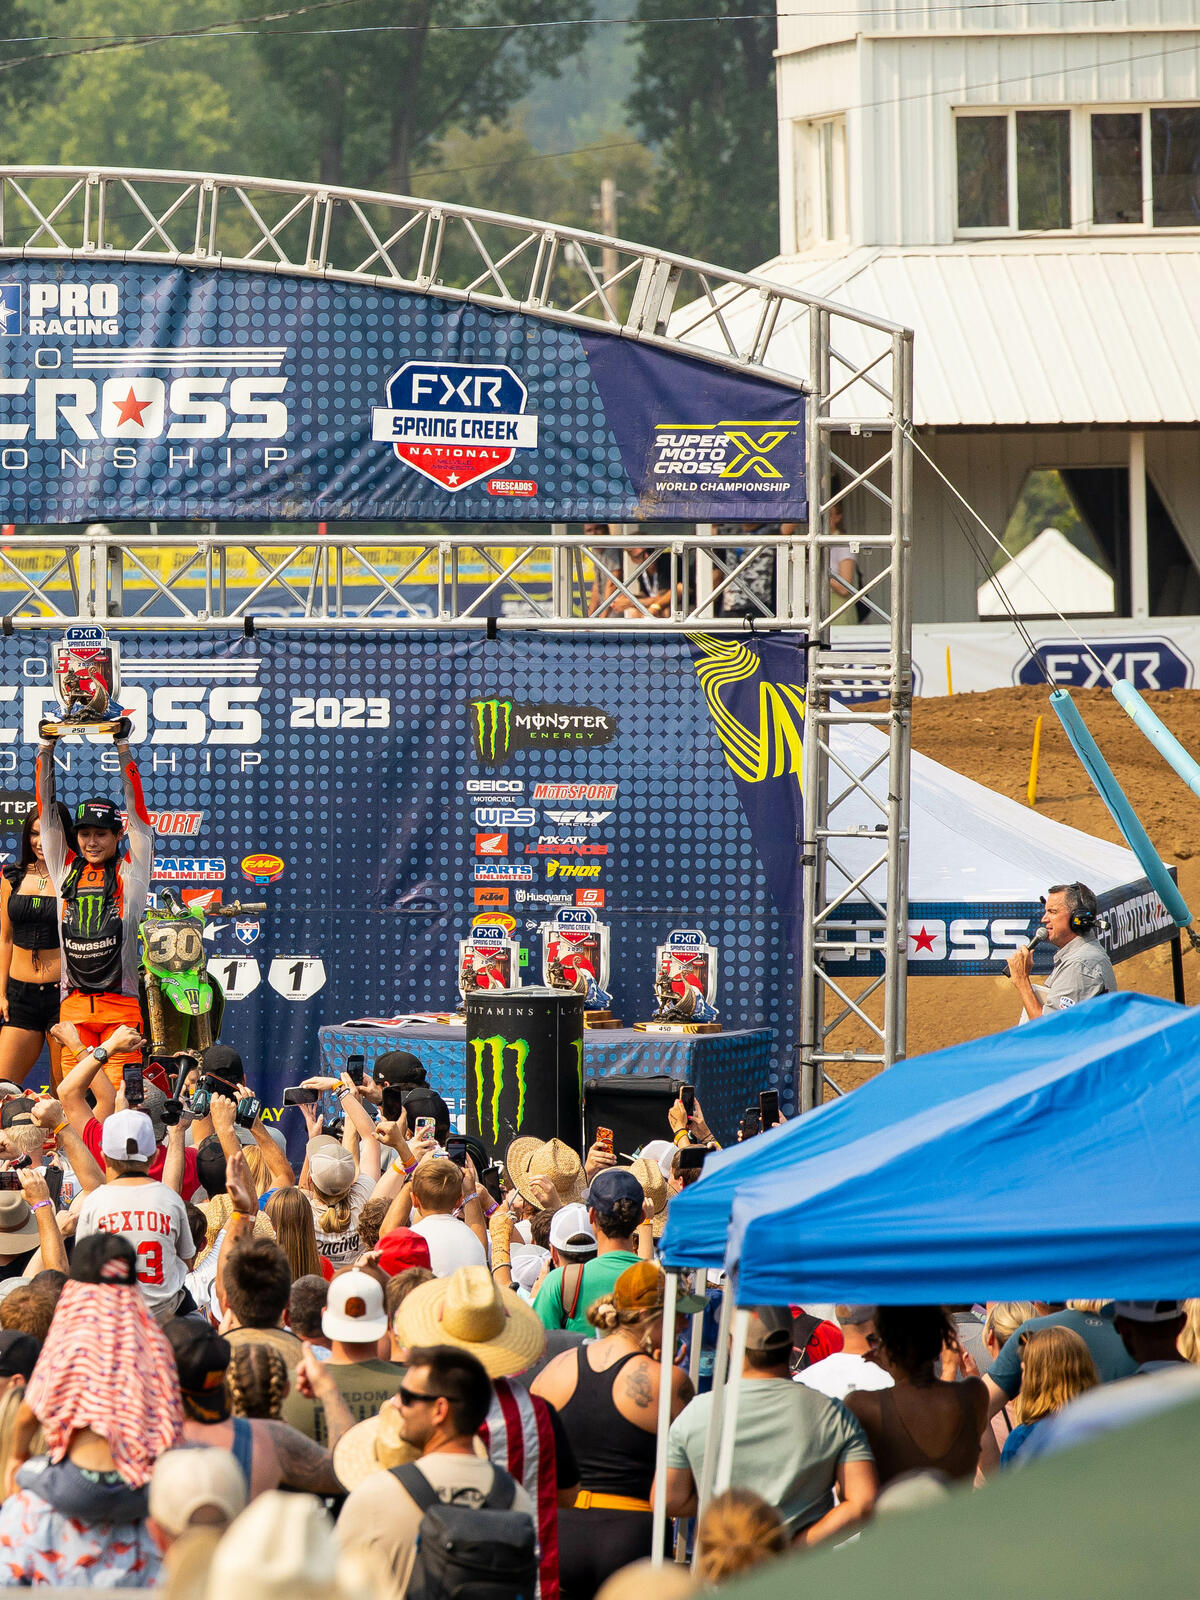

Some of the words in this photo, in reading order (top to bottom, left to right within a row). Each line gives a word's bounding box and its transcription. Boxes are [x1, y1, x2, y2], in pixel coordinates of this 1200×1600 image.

[30, 284, 119, 316] PRO
[29, 319, 119, 336] RACING
[411, 372, 502, 408] FXR
[392, 416, 456, 438] SPRING
[461, 418, 519, 441] CREEK
[655, 434, 731, 447] SUPER
[409, 447, 500, 459] NATIONAL
[659, 448, 725, 461] MOTO
[653, 461, 727, 474] CROSS
[491, 481, 533, 491] FRESCADOS
[656, 482, 698, 492] WORLD
[700, 483, 791, 492] CHAMPIONSHIP
[72, 629, 97, 638] FXR
[56, 657, 71, 673] 3
[290, 697, 390, 728] 2023
[515, 713, 609, 730] MONSTER
[466, 780, 523, 792] GEICO
[475, 808, 535, 827] WPS
[544, 811, 613, 823] FLY
[538, 836, 587, 845] MX-ATV
[524, 844, 609, 856] LEGENDS
[153, 858, 225, 871] PARTS
[244, 859, 282, 869] FMF
[475, 865, 532, 874] PARTS
[559, 865, 602, 877] THOR
[479, 892, 504, 901] KTM
[527, 893, 573, 904] Husqvarna
[563, 911, 587, 922] FXR
[477, 928, 499, 938] FXR
[674, 934, 697, 943] FXR
[65, 935, 117, 951] Kawasaki
[148, 926, 203, 964] 30
[68, 951, 82, 959] PRO
[466, 1005, 535, 1016] VITAMINS
[98, 1210, 171, 1236] SEXTON
